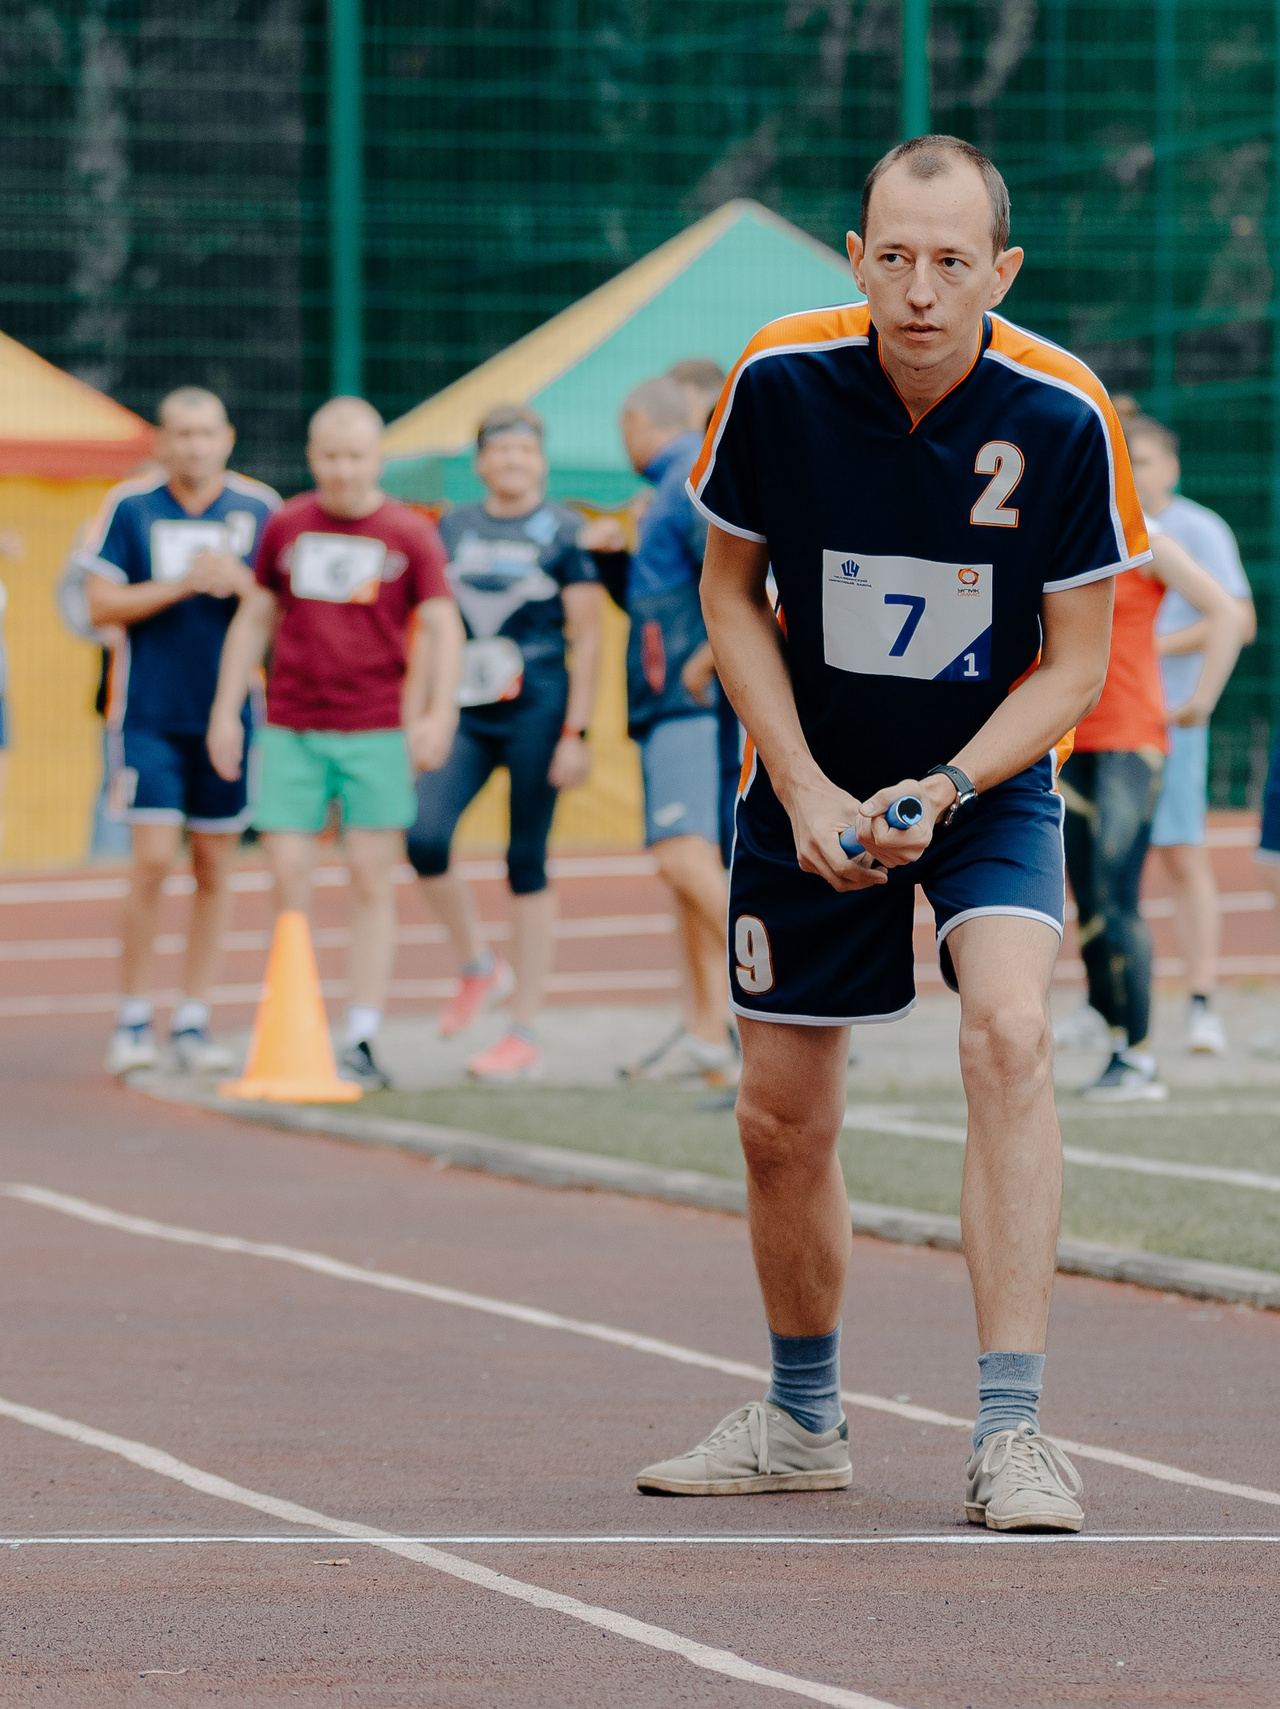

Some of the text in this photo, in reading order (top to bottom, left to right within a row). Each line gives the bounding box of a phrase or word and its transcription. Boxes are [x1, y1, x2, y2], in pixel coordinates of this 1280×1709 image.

[970, 440, 1025, 528] 2
[884, 593, 926, 657] 7
[963, 652, 979, 677] 1
[735, 914, 776, 995] 9
